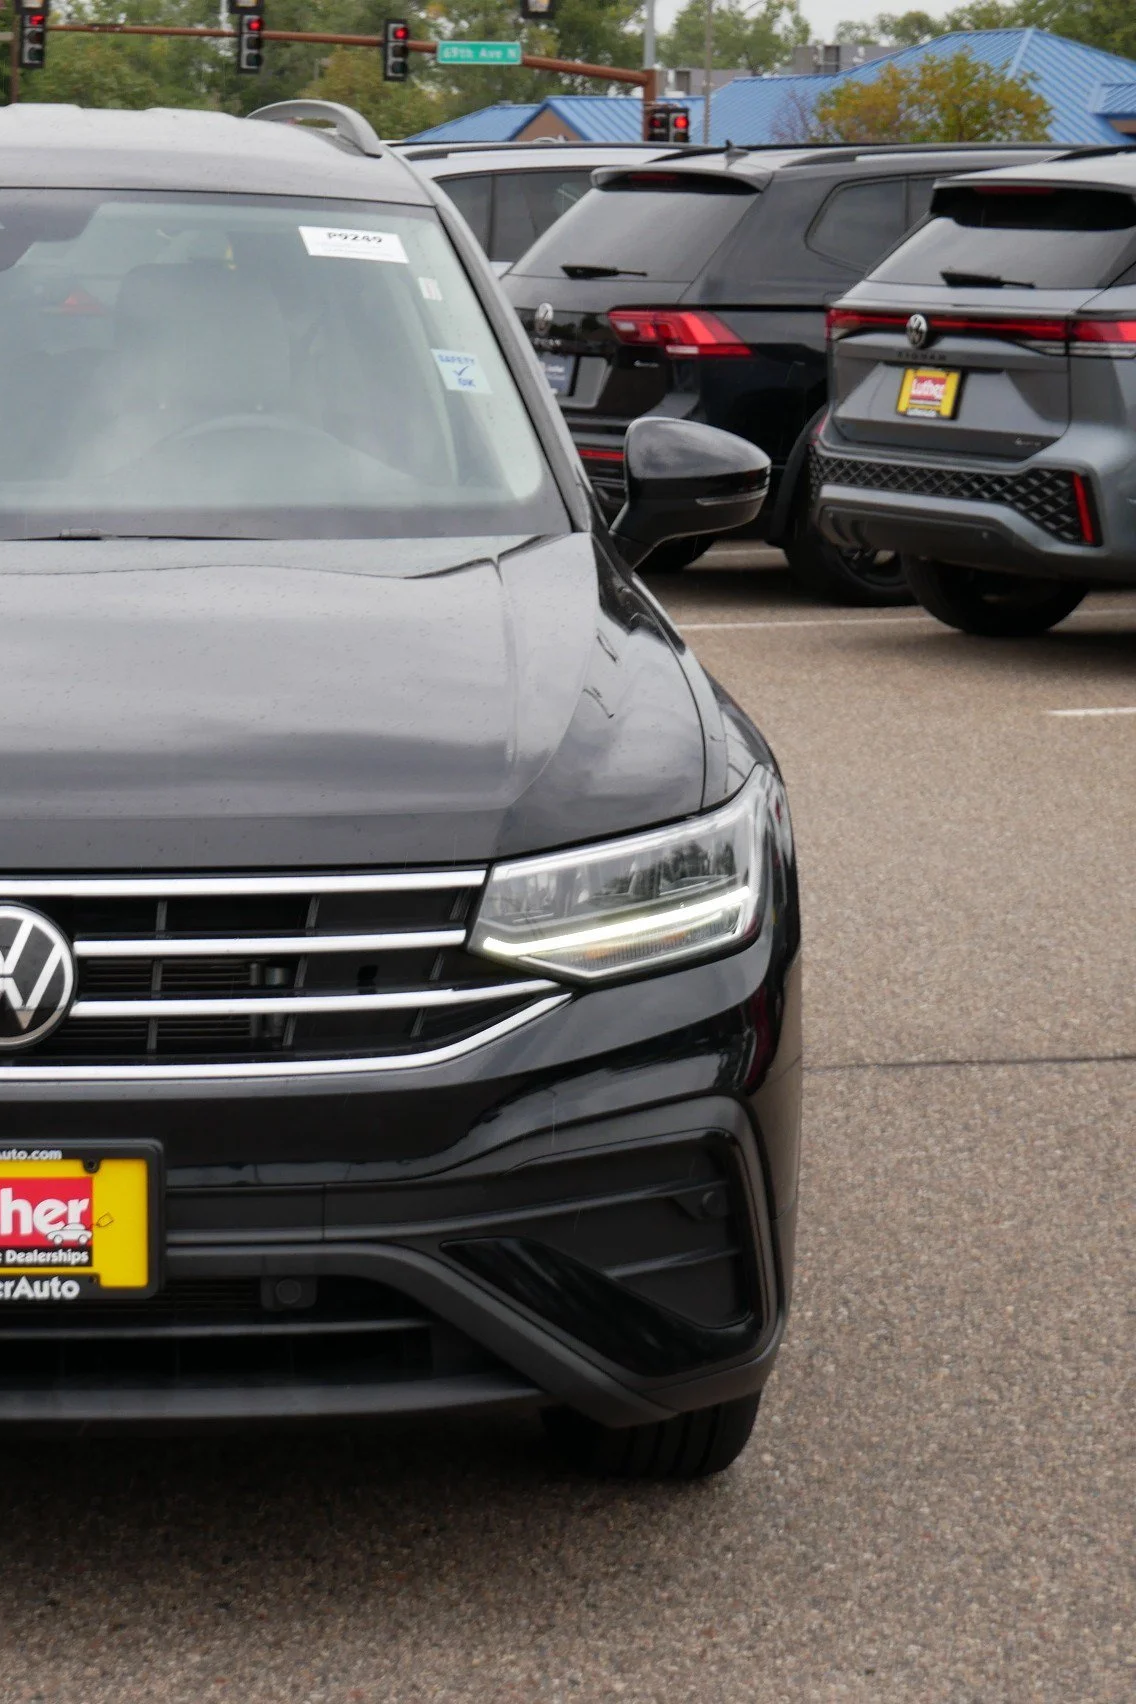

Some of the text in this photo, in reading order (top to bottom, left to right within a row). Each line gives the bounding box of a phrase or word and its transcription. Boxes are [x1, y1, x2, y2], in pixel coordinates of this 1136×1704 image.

[479, 48, 503, 58] Ave
[508, 48, 517, 58] N
[5, 1250, 89, 1266] Dealerships
